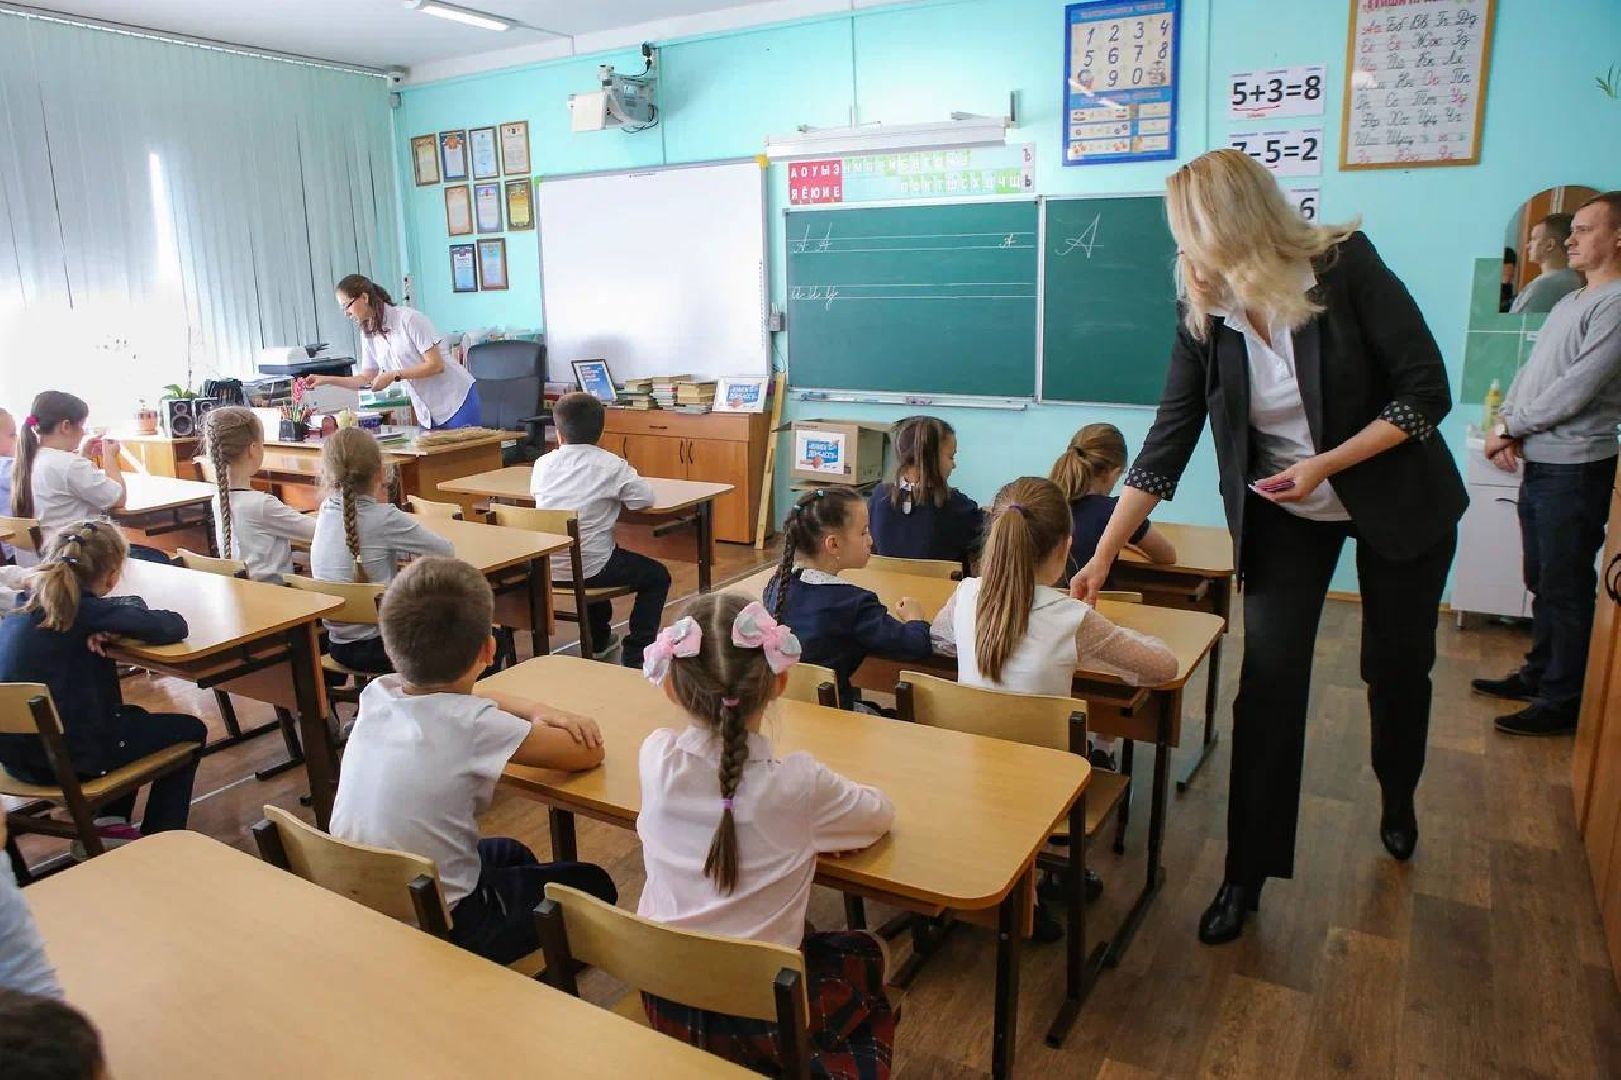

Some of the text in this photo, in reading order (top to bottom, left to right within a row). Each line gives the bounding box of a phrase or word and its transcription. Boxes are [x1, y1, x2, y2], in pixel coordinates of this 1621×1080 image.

[1109, 24, 1119, 41] 2
[1134, 22, 1144, 39] 3
[1084, 41, 1168, 67] 5 6 7 8
[1108, 70, 1118, 87] 9
[1232, 75, 1320, 105] 5+3=8
